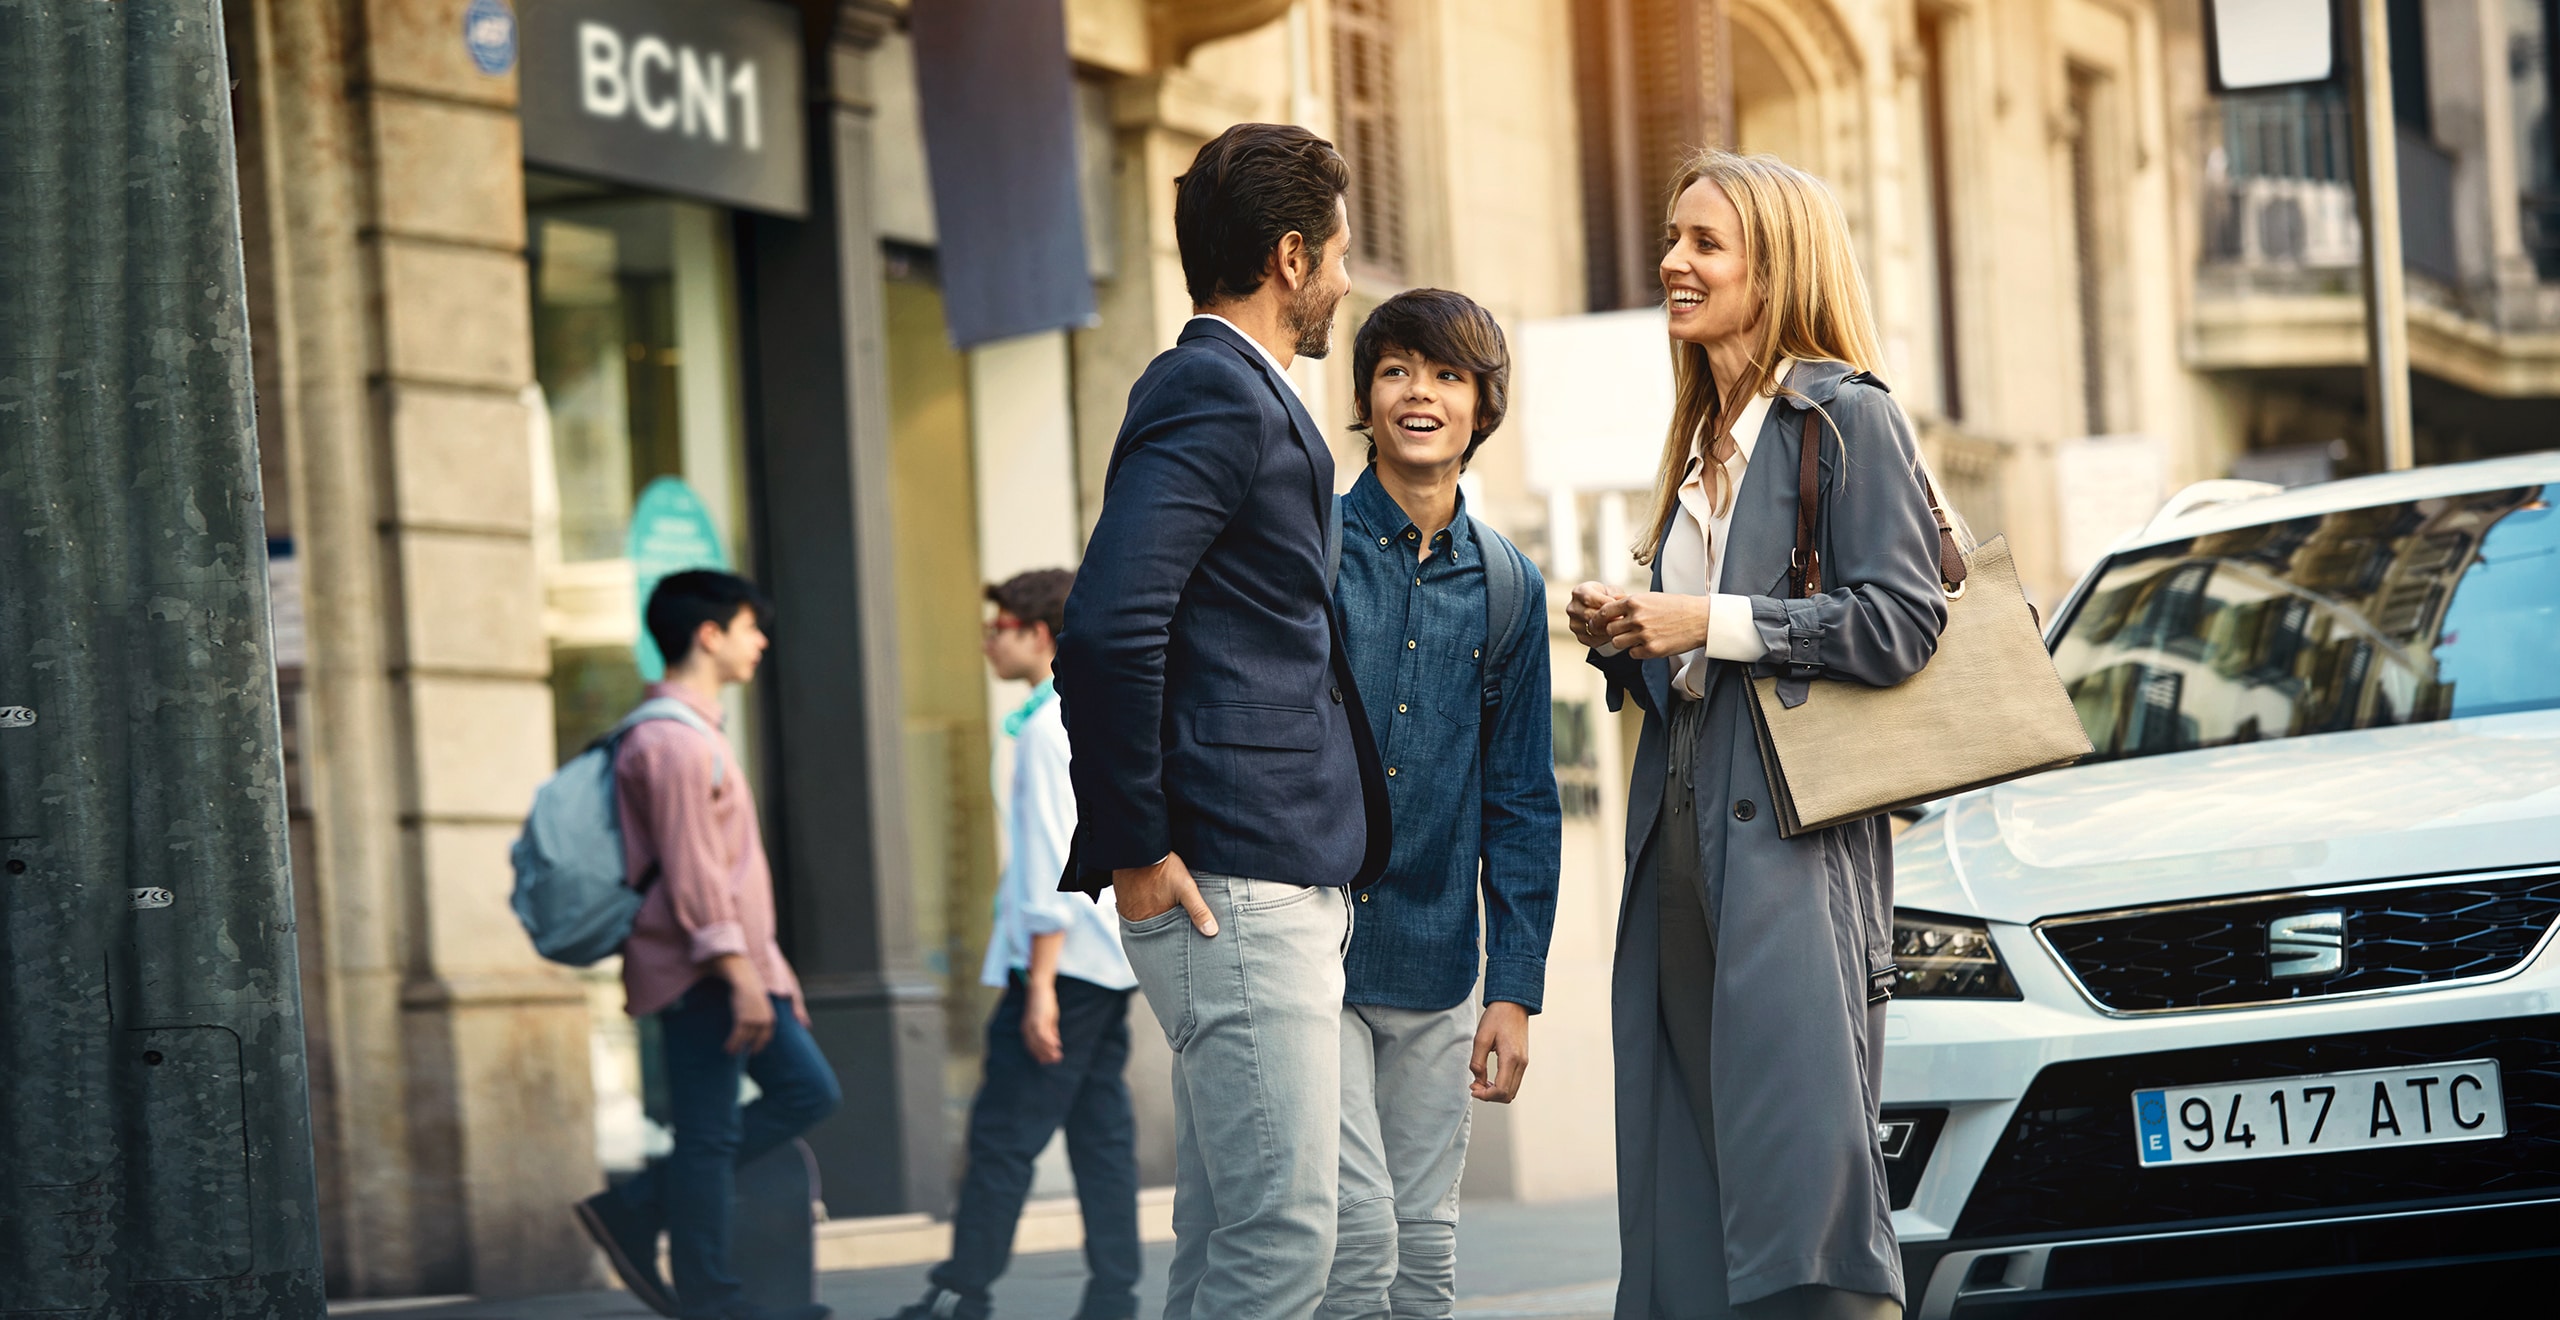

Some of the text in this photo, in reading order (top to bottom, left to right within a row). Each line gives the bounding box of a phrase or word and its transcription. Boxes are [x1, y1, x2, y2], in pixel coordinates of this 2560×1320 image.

[579, 22, 761, 151] BCN1
[2148, 1133, 2164, 1151] E
[2179, 1073, 2486, 1153] 9417 ATC
